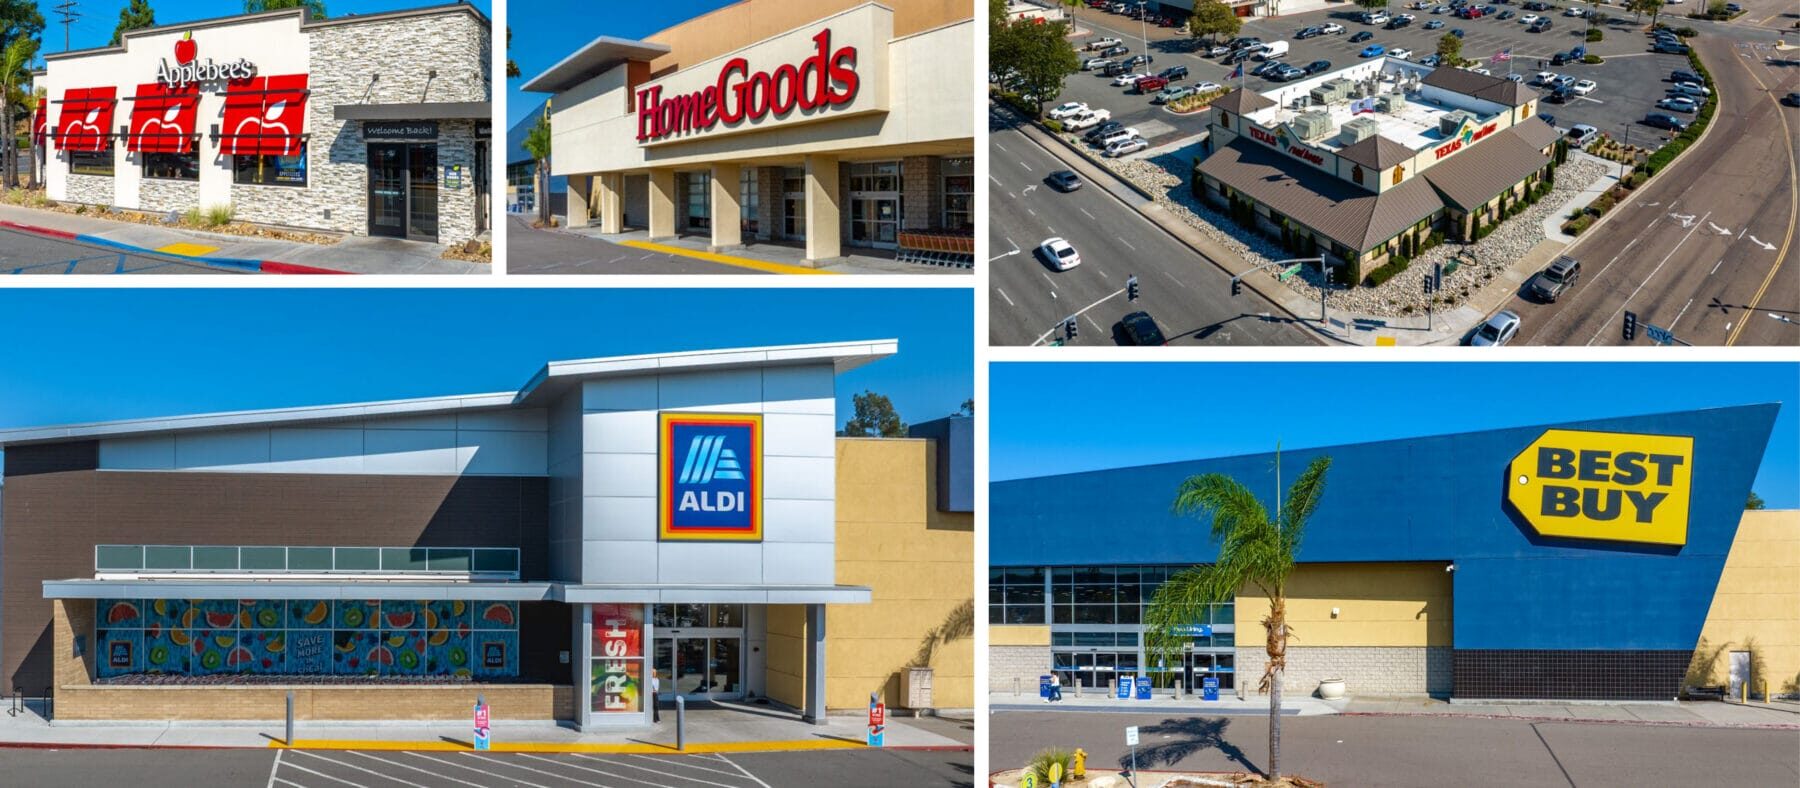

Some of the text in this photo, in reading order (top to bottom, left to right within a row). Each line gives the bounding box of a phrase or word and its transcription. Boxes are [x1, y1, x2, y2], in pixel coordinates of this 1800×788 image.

[157, 57, 253, 88] Applebee's
[636, 28, 859, 140] HomeGoods
[367, 127, 432, 135] Welcome Back!
[1249, 126, 1277, 146] TEXAS
[1435, 138, 1461, 160] TEXAS
[1537, 447, 1684, 487] BEST
[678, 491, 744, 512] ALDI
[1541, 485, 1669, 524] BUY
[297, 635, 323, 648] SAVE
[297, 646, 322, 658] MORE
[605, 619, 627, 709] FRESH
[1026, 777, 1033, 788] 3
